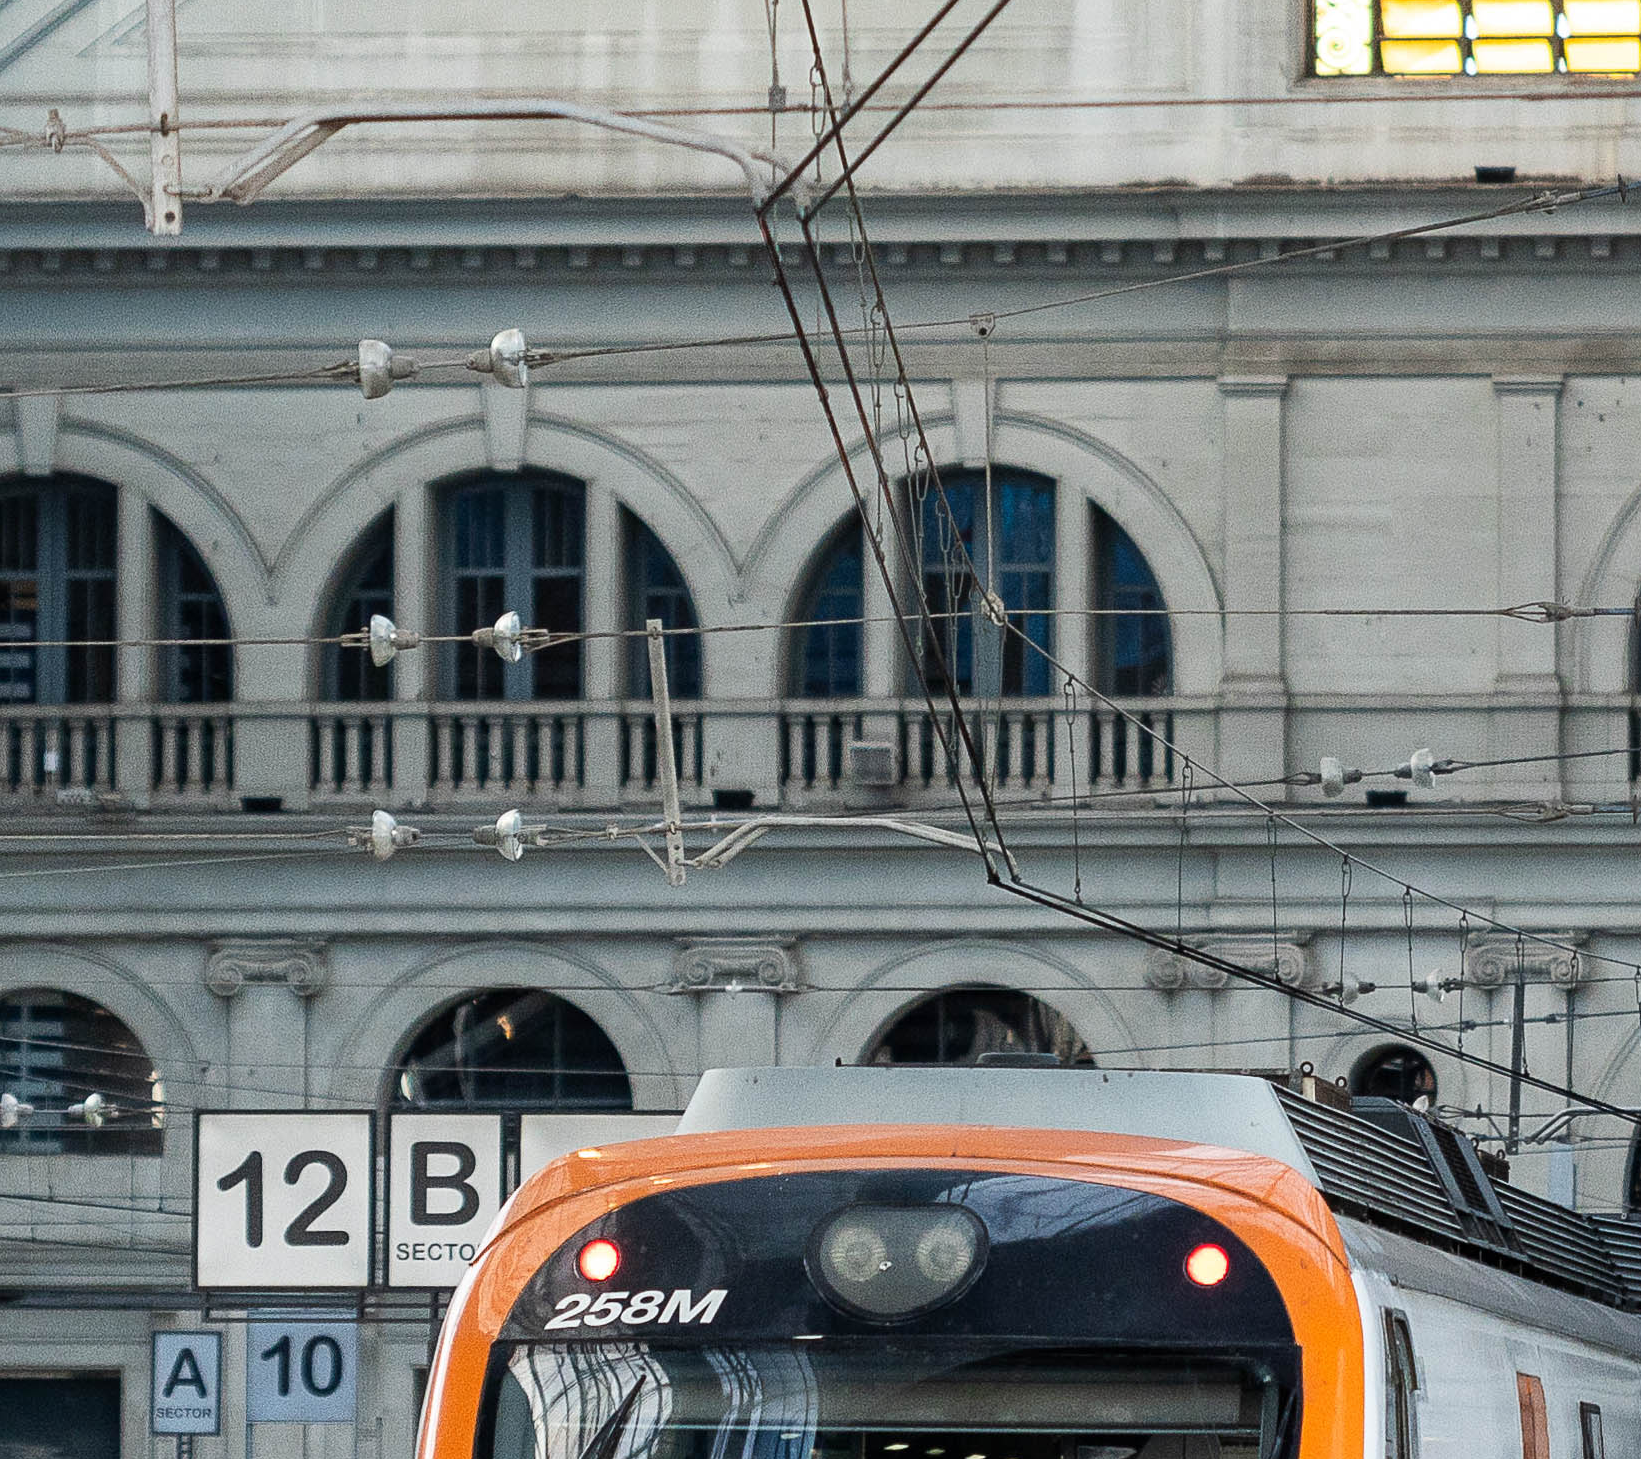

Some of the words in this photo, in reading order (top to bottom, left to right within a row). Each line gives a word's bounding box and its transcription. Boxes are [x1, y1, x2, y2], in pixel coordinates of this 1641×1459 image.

[216, 1149, 350, 1248] 12
[410, 1141, 479, 1225] B
[395, 1242, 478, 1262] SECTO
[543, 1289, 728, 1330] 258M
[162, 1347, 208, 1398] A
[260, 1335, 343, 1397] 10
[156, 1406, 213, 1419] SECTOR
